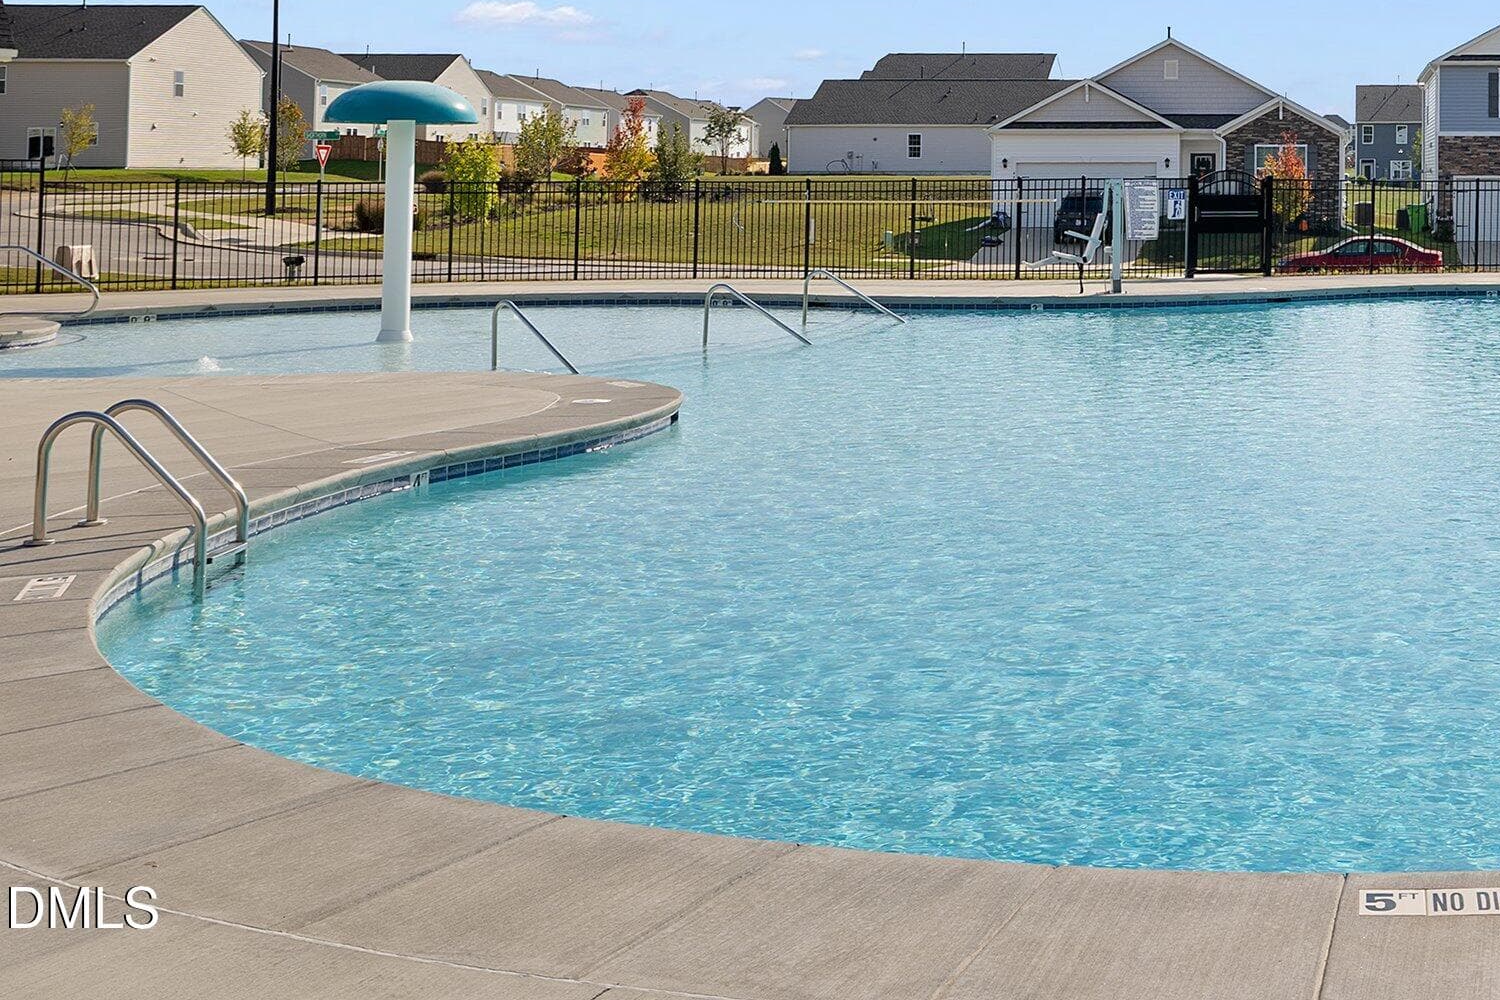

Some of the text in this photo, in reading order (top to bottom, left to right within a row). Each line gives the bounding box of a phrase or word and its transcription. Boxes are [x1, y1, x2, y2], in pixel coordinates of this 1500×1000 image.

[1169, 190, 1184, 200] EXIT
[1365, 893, 1397, 911] 5
[1432, 892, 1465, 912] NO
